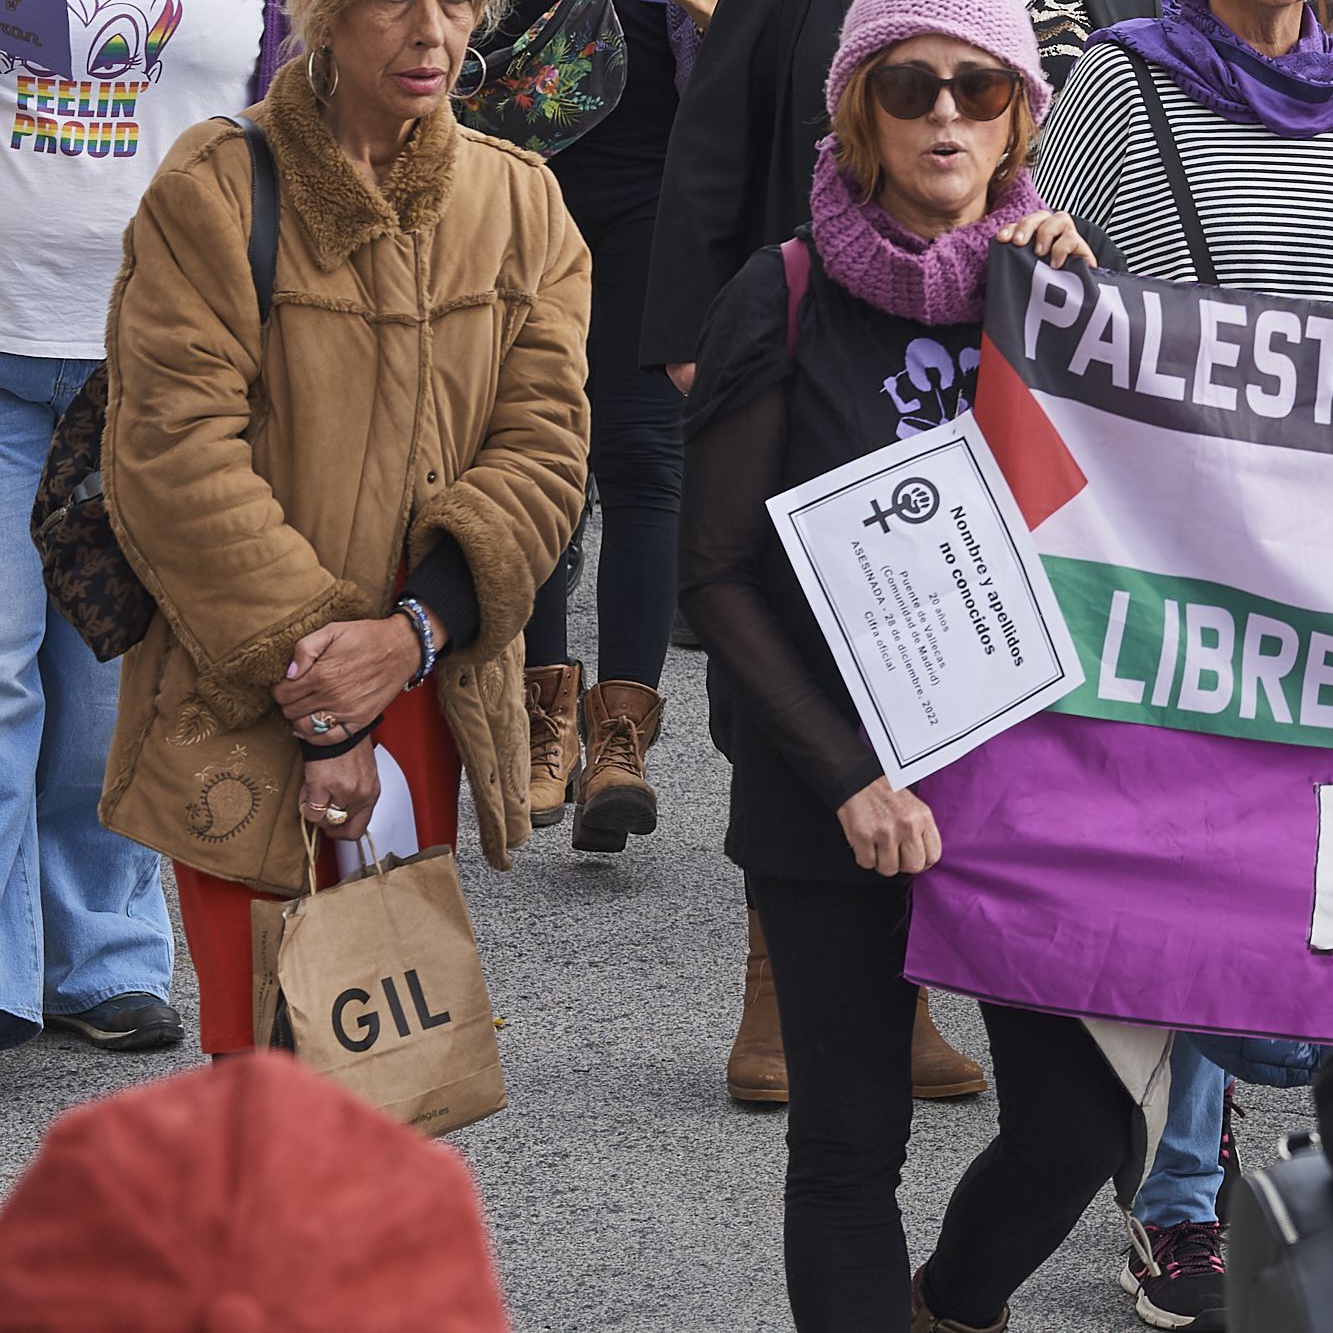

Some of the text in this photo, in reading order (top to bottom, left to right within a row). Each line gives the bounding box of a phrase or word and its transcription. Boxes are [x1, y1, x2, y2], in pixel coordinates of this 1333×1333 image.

[10, 112, 139, 159] PROUD
[851, 540, 886, 606] ASESINADA
[891, 627, 901, 641] de
[921, 700, 939, 726] 2022
[880, 564, 941, 686] (Comunidad de Madrid)
[900, 570, 946, 669] Puente de Vallecas
[928, 592, 949, 633] 20 años
[939, 541, 996, 656] no conocidos
[950, 505, 1024, 668] Nombre y apellidos
[863, 611, 896, 672] Cifra oficial
[332, 969, 451, 1053] GIL
